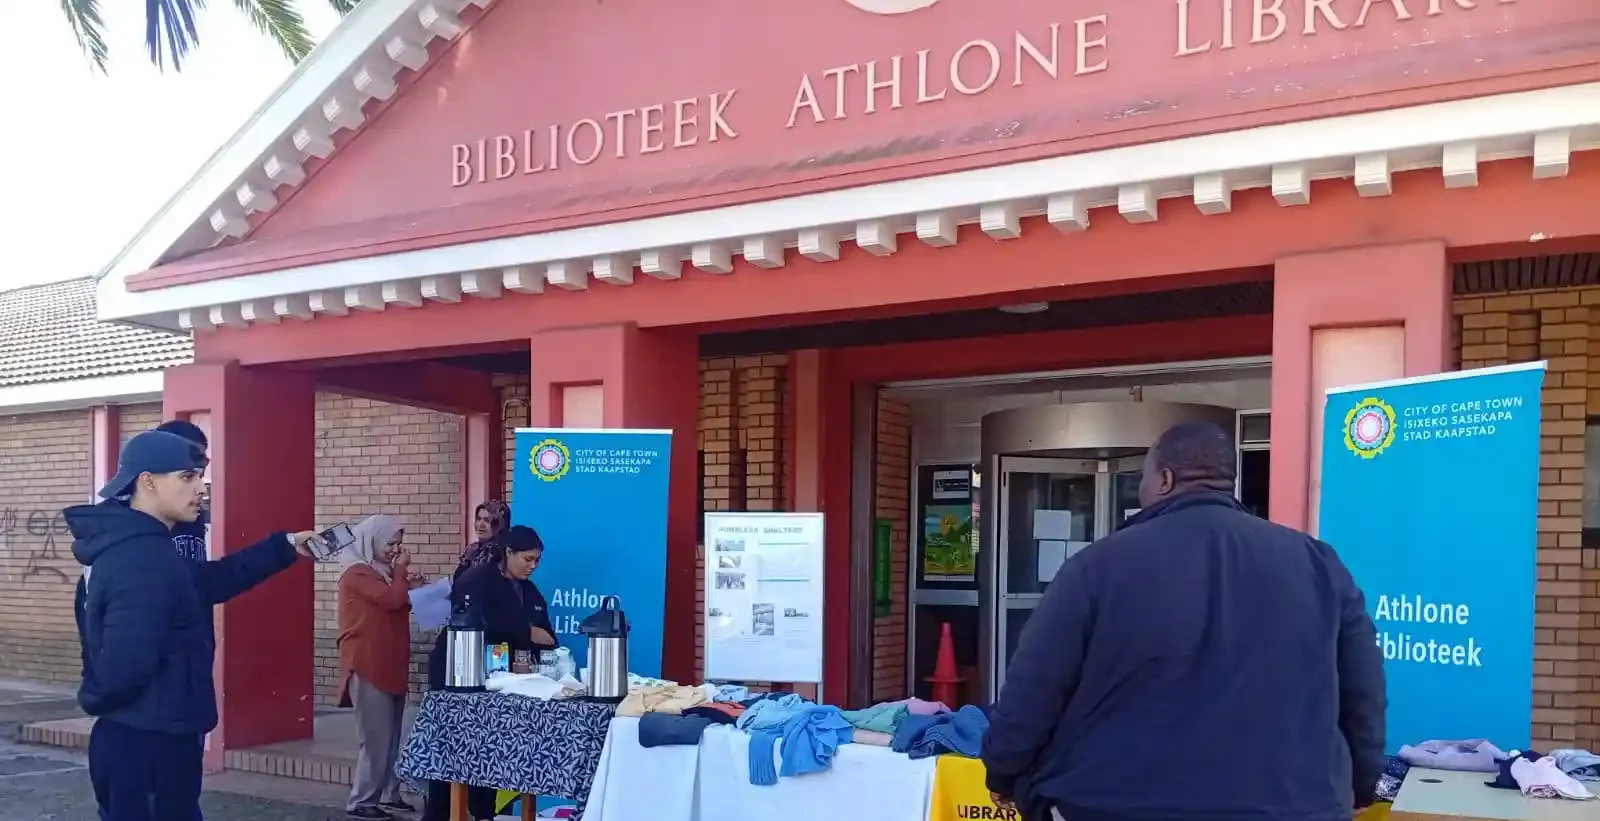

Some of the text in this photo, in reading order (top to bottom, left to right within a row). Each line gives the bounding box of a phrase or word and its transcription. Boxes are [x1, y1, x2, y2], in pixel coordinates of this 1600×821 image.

[452, 89, 738, 188] BIBLIOTEEK
[785, 20, 1109, 129] ATHLONE
[1404, 396, 1523, 417] CITY OF CAPE TOWN
[1404, 411, 1512, 429] ISIXEKO SASEKAPA
[1403, 425, 1496, 441] STAD KAAPSTAD
[576, 449, 593, 457] CITY
[596, 449, 608, 457] OF
[610, 449, 631, 457] CAPE
[576, 465, 640, 474] STAD KAAPSTAD
[551, 588, 621, 609] Athlon
[1375, 593, 1470, 625] Athlone
[1375, 632, 1483, 667] iblioteek
[957, 804, 1018, 821] LIBRAR
